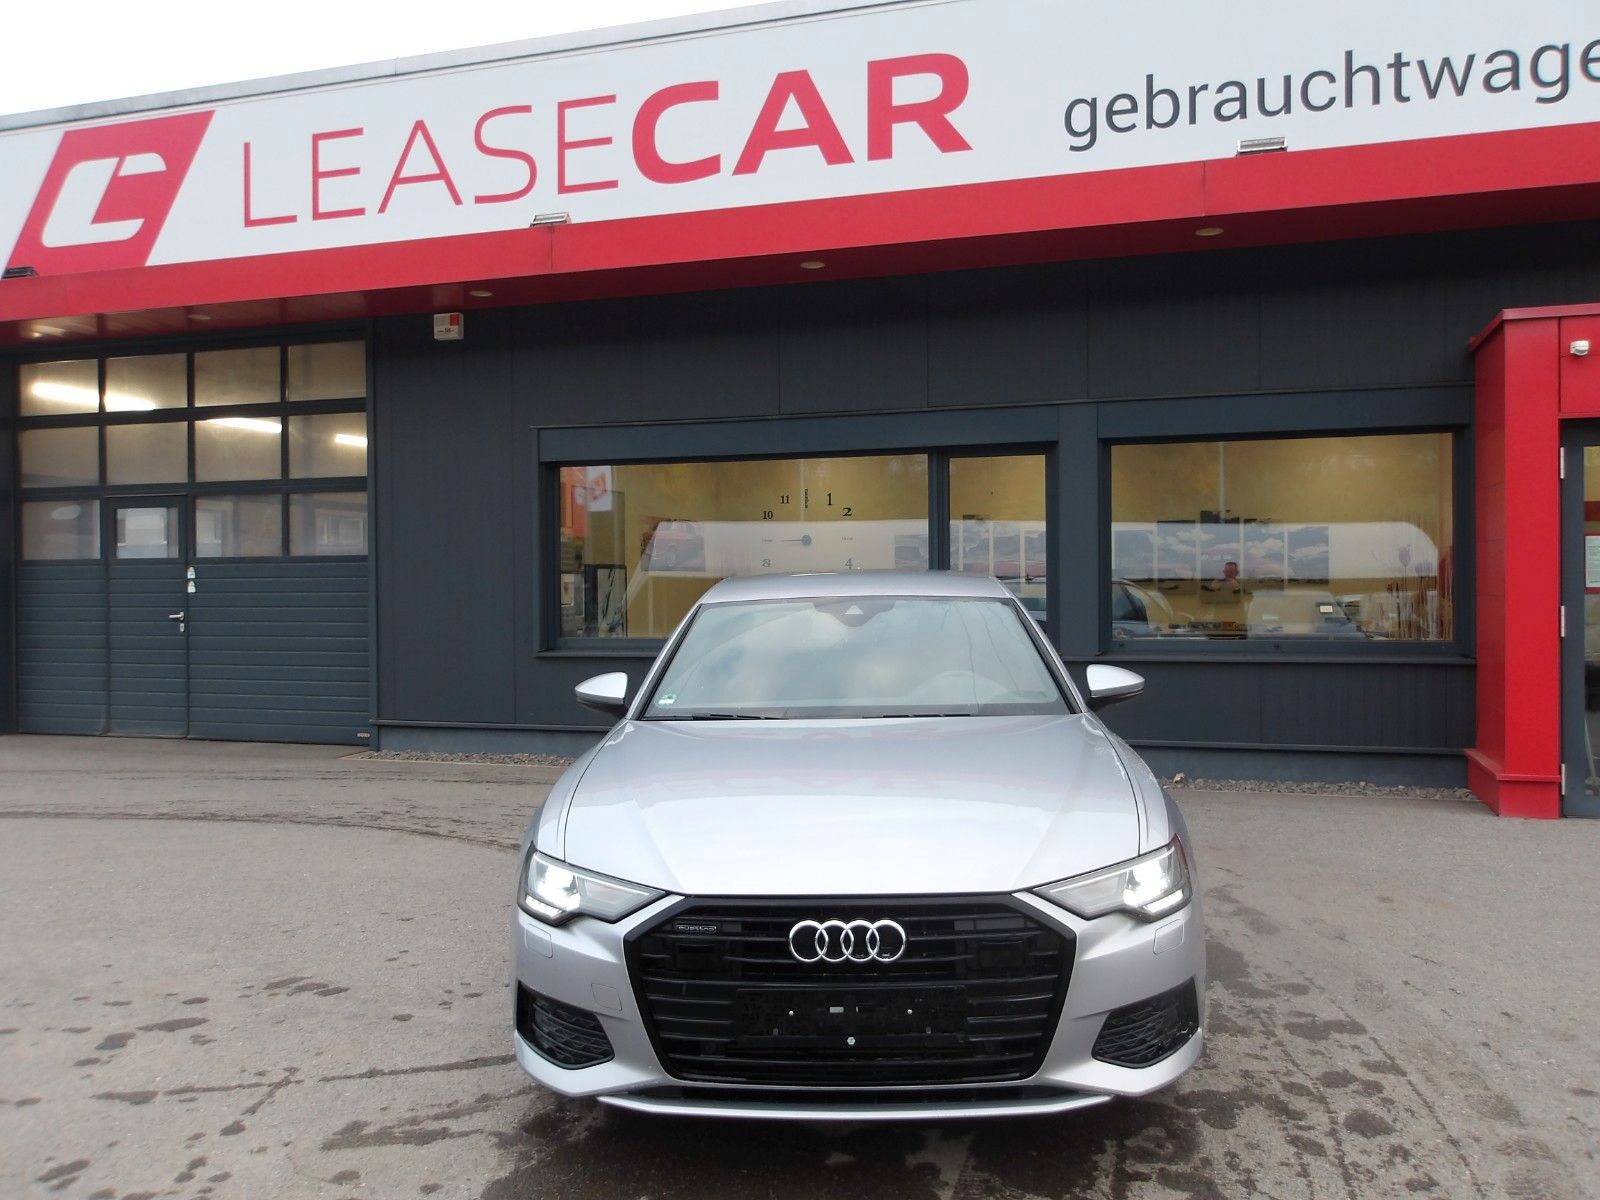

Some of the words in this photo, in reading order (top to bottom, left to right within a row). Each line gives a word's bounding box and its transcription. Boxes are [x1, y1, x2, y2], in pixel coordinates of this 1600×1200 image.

[243, 53, 974, 229] LEASECAR
[780, 495, 789, 504] 11
[827, 492, 833, 506] 1
[762, 510, 773, 519] 10
[842, 507, 852, 517] 2
[844, 558, 853, 570] 4
